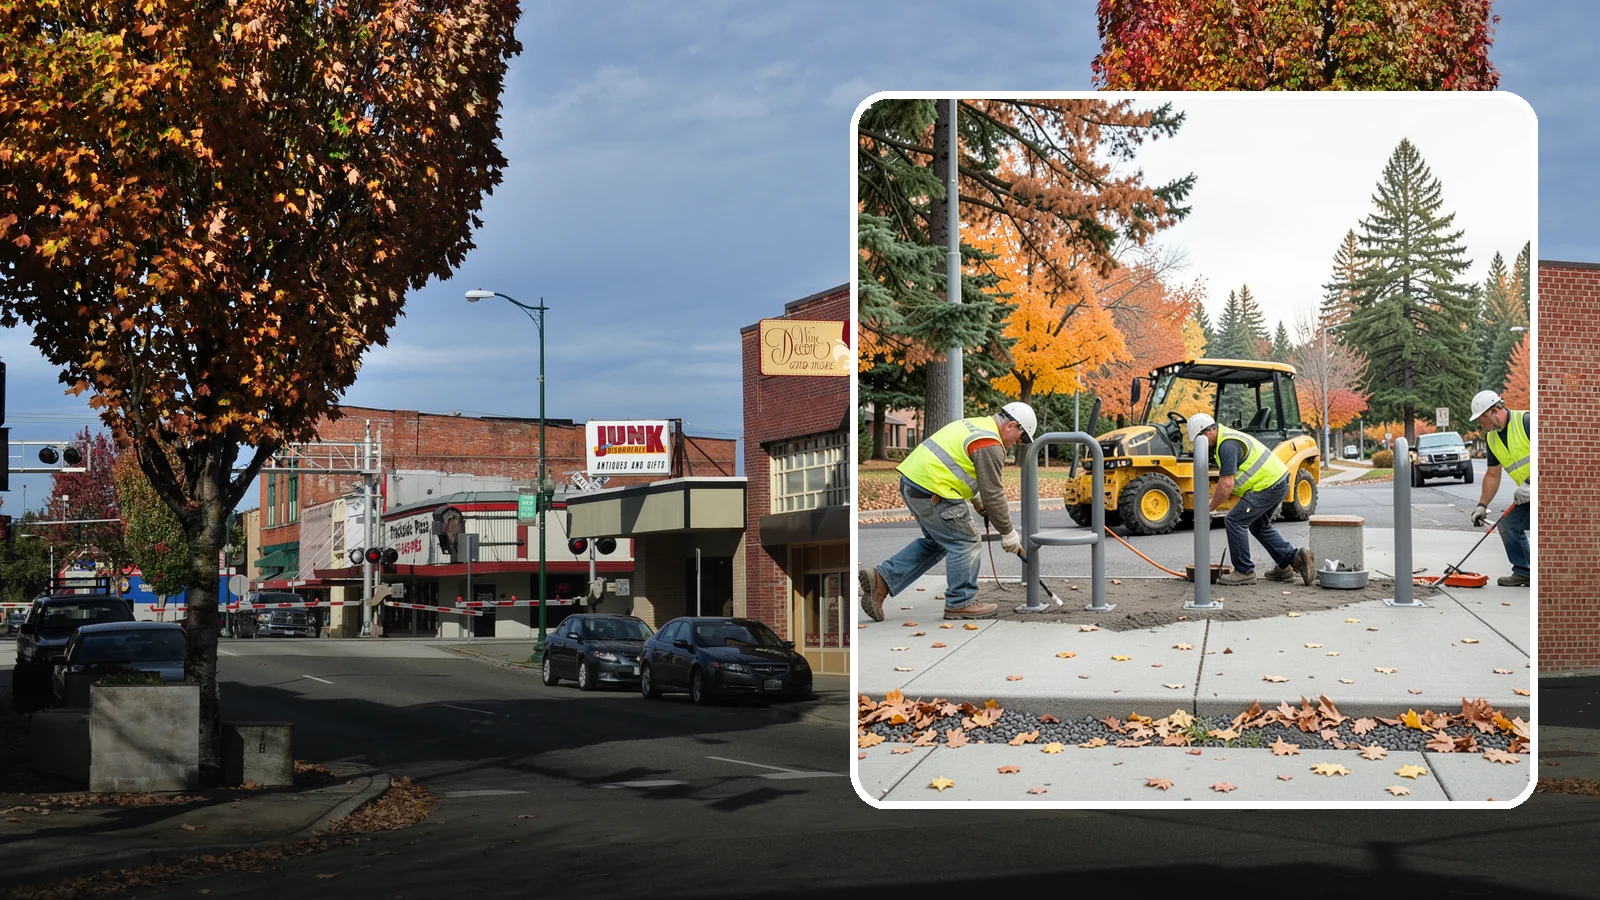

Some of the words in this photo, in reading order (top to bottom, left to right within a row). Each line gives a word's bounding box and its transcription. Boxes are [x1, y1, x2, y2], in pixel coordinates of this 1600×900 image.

[764, 327, 831, 365] Decor
[595, 425, 665, 457] JUNK
[607, 446, 646, 454] DISORDERLY
[596, 461, 628, 470] ANTIQUES
[630, 461, 644, 470] AND
[646, 460, 666, 469] GIFTS
[389, 522, 413, 539] Trackside
[414, 519, 429, 535] Pizza
